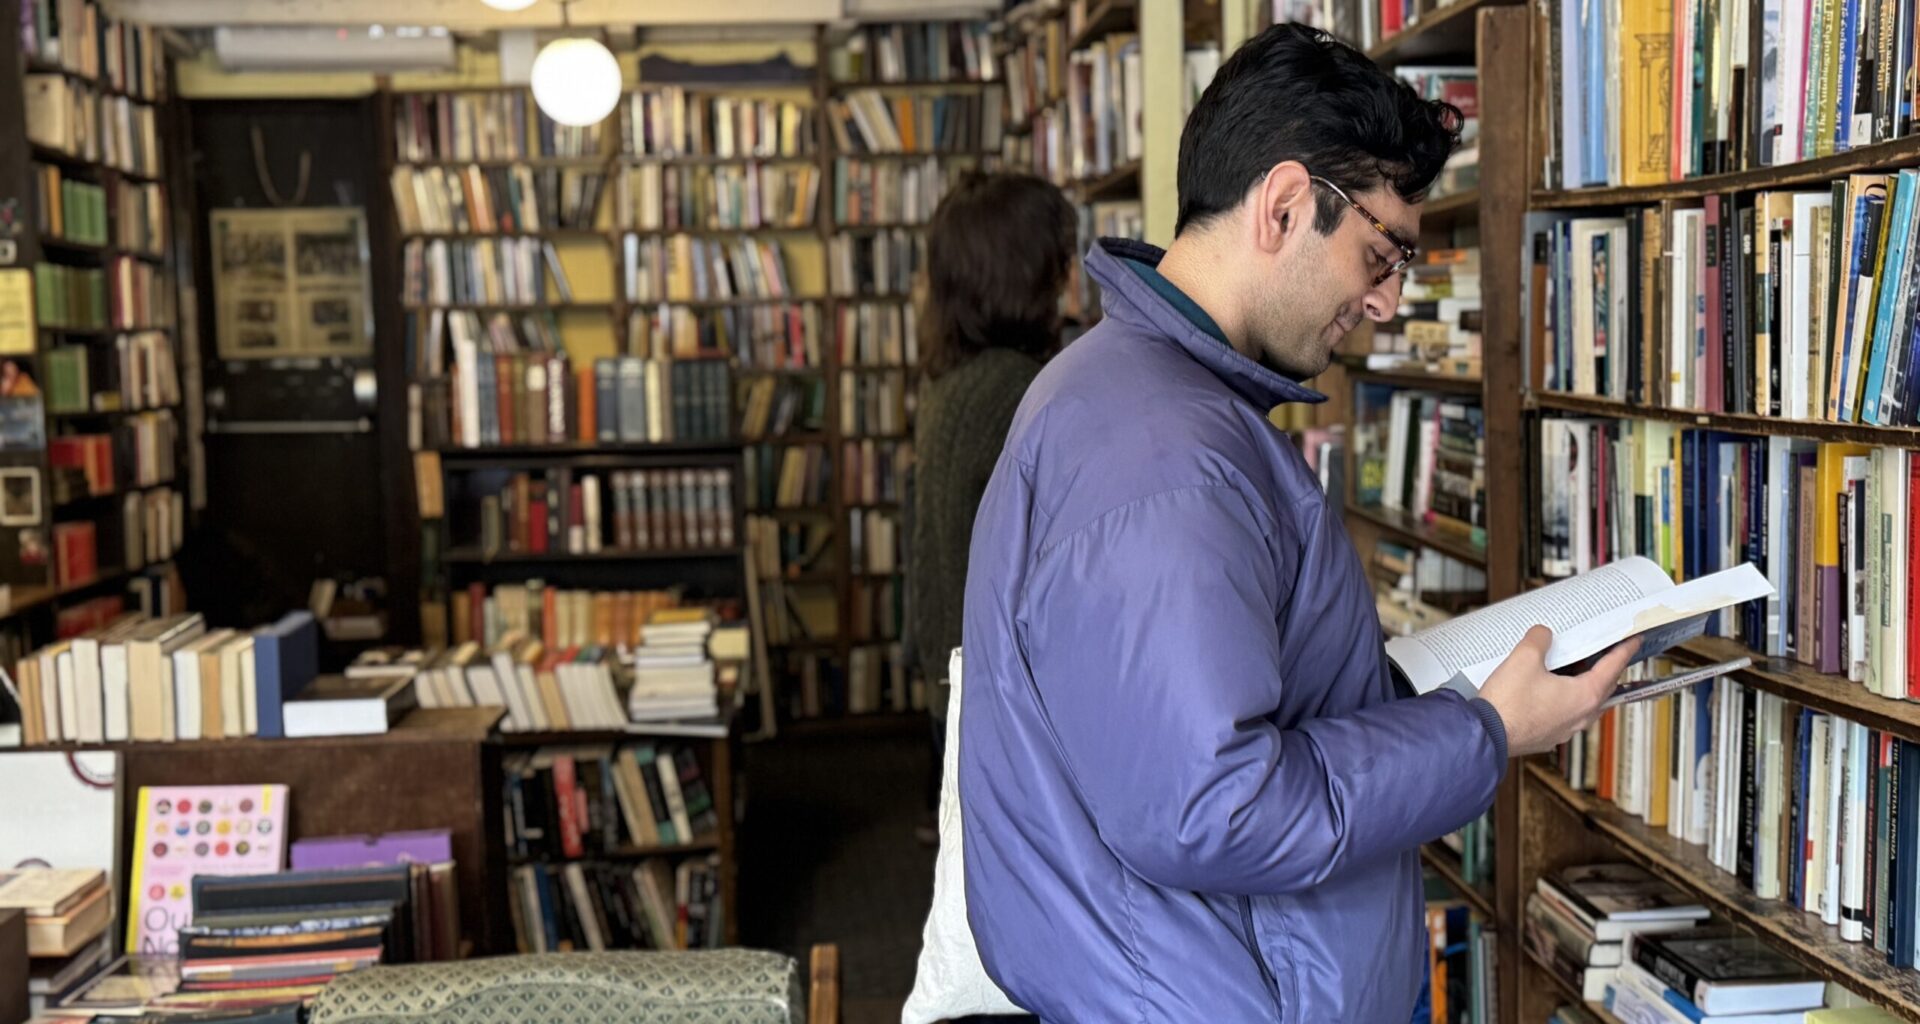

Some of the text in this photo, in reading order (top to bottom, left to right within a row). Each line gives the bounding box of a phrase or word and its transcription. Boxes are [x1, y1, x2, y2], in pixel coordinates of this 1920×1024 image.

[1819, 23, 1832, 109] Autobiography
[1817, 112, 1827, 134] The
[1724, 227, 1732, 293] CONNECTIONS
[1746, 722, 1754, 771] THEORY
[1746, 776, 1753, 793] OF
[1745, 796, 1753, 847] JUSTICE
